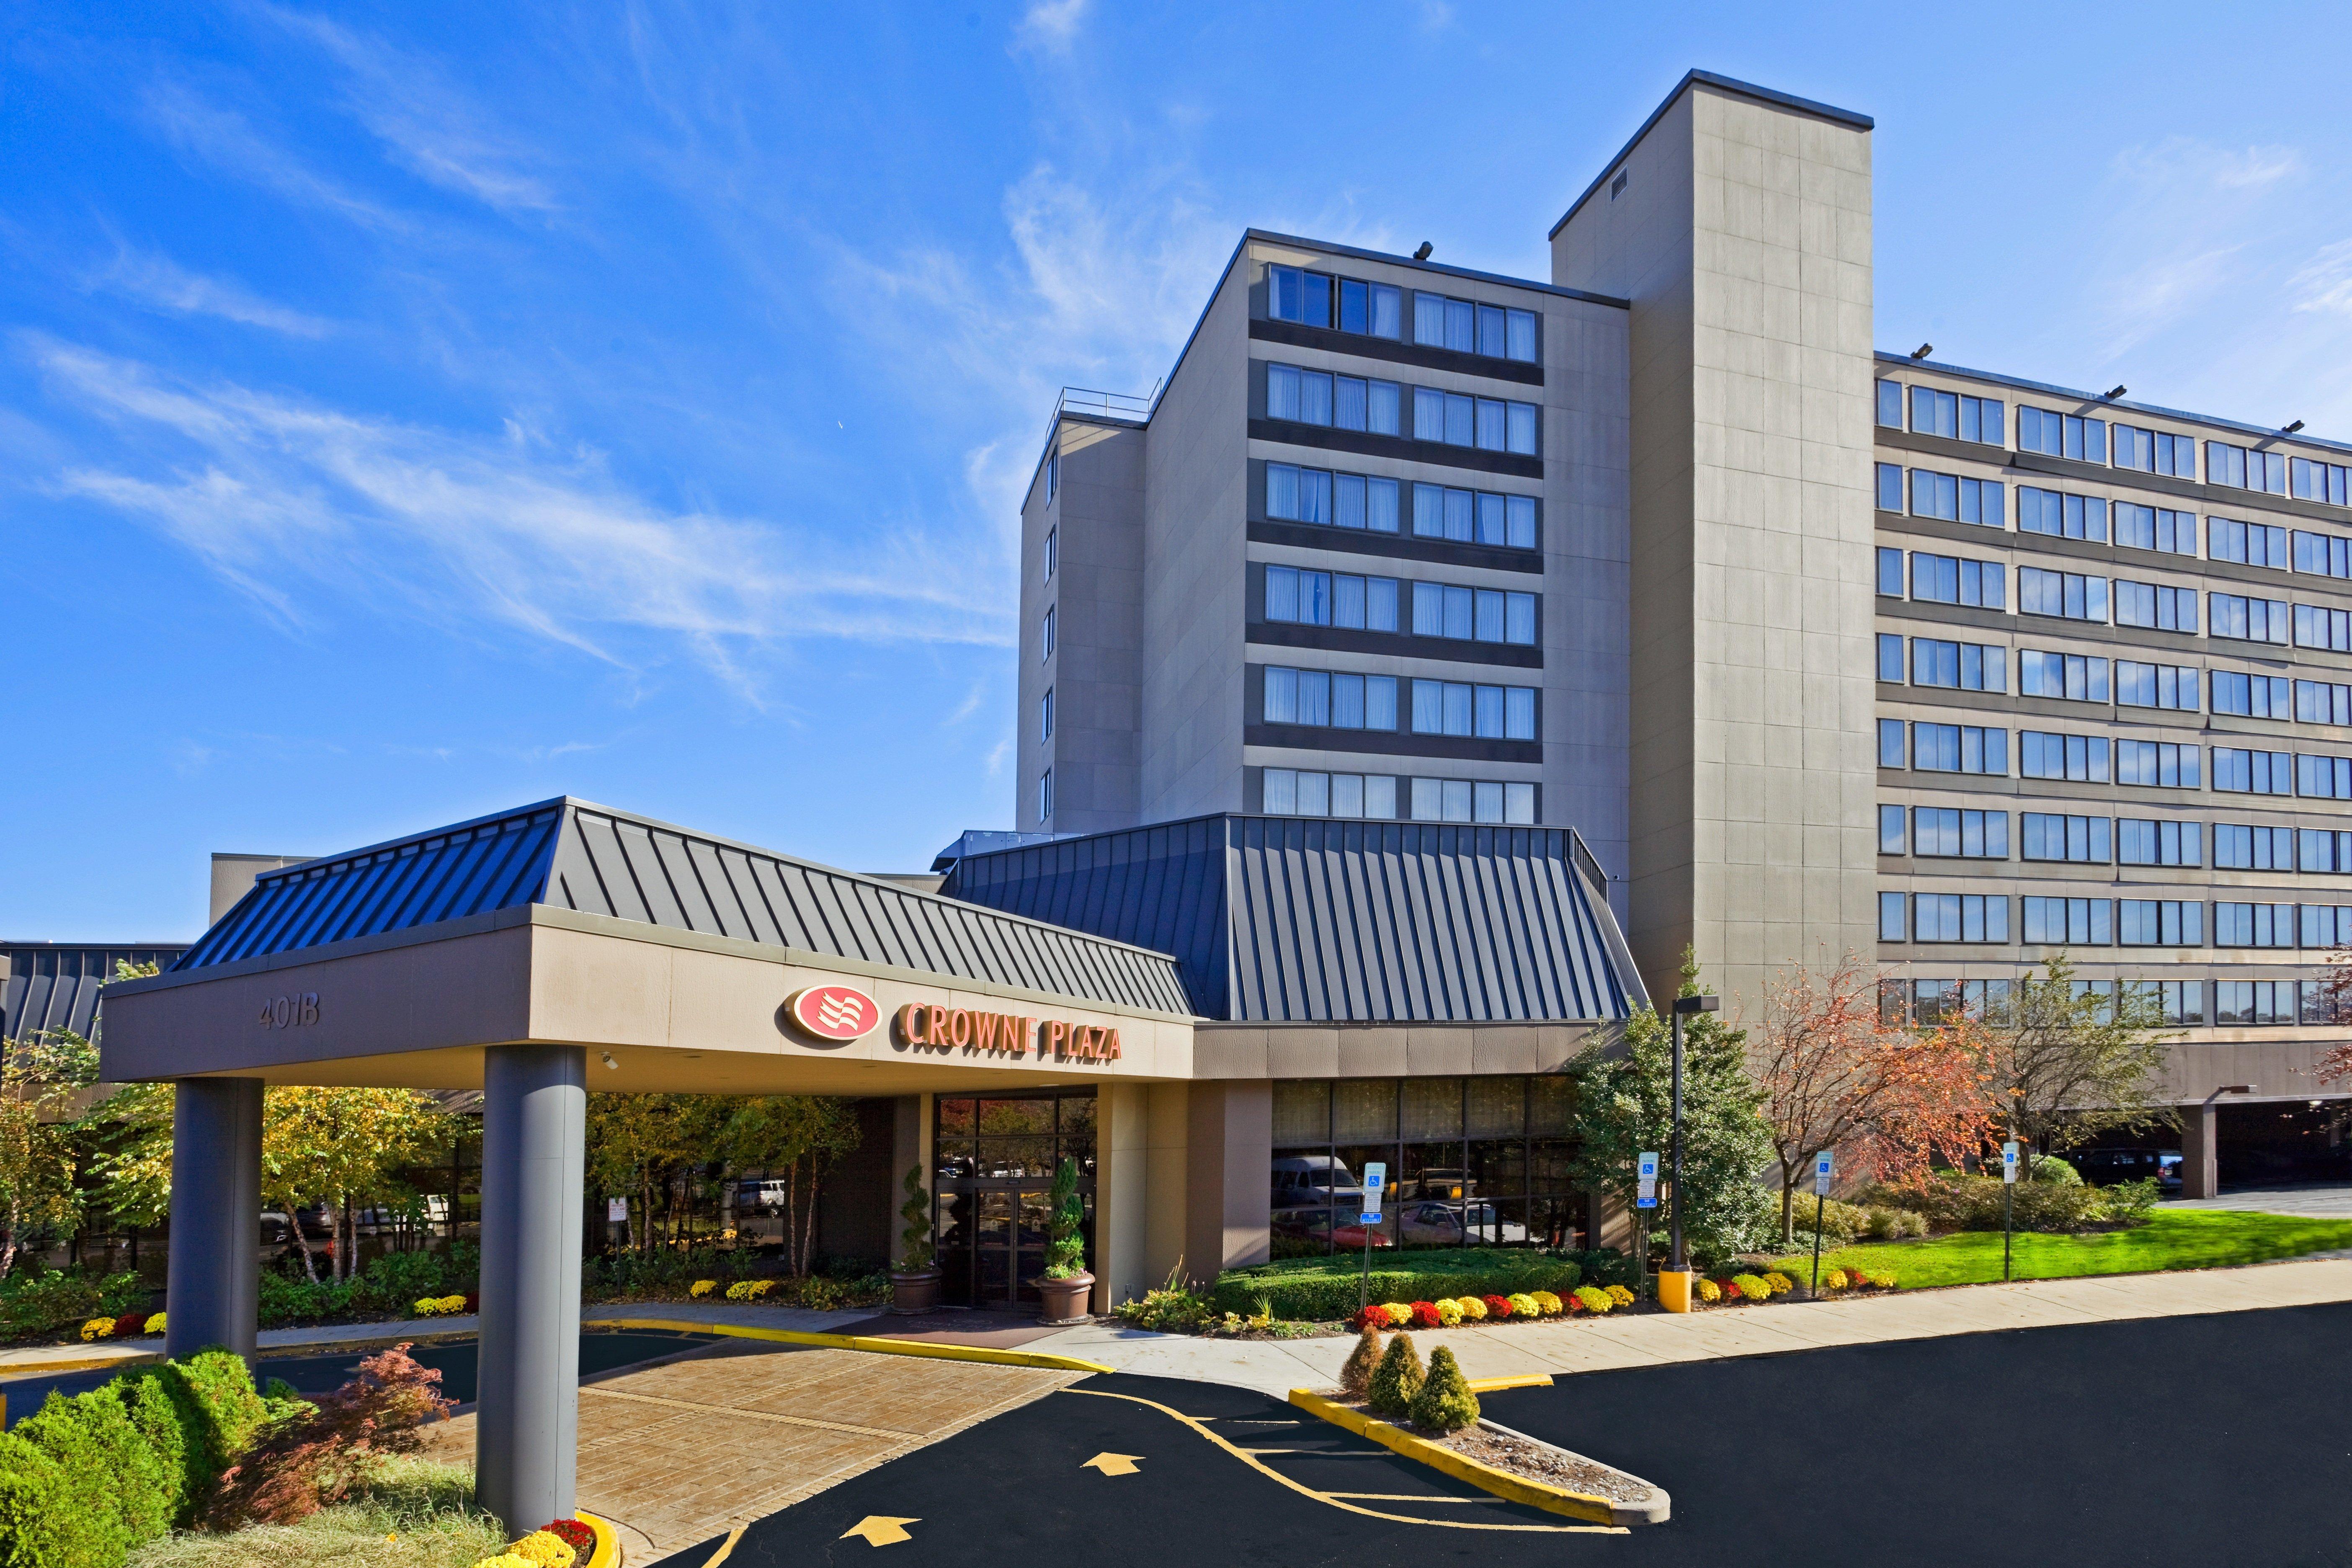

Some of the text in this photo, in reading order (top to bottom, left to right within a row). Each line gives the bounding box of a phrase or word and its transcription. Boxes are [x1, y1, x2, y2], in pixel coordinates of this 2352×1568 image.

[259, 992, 320, 1030] 401B
[906, 1001, 1122, 1060] CROWNE PLAZA
